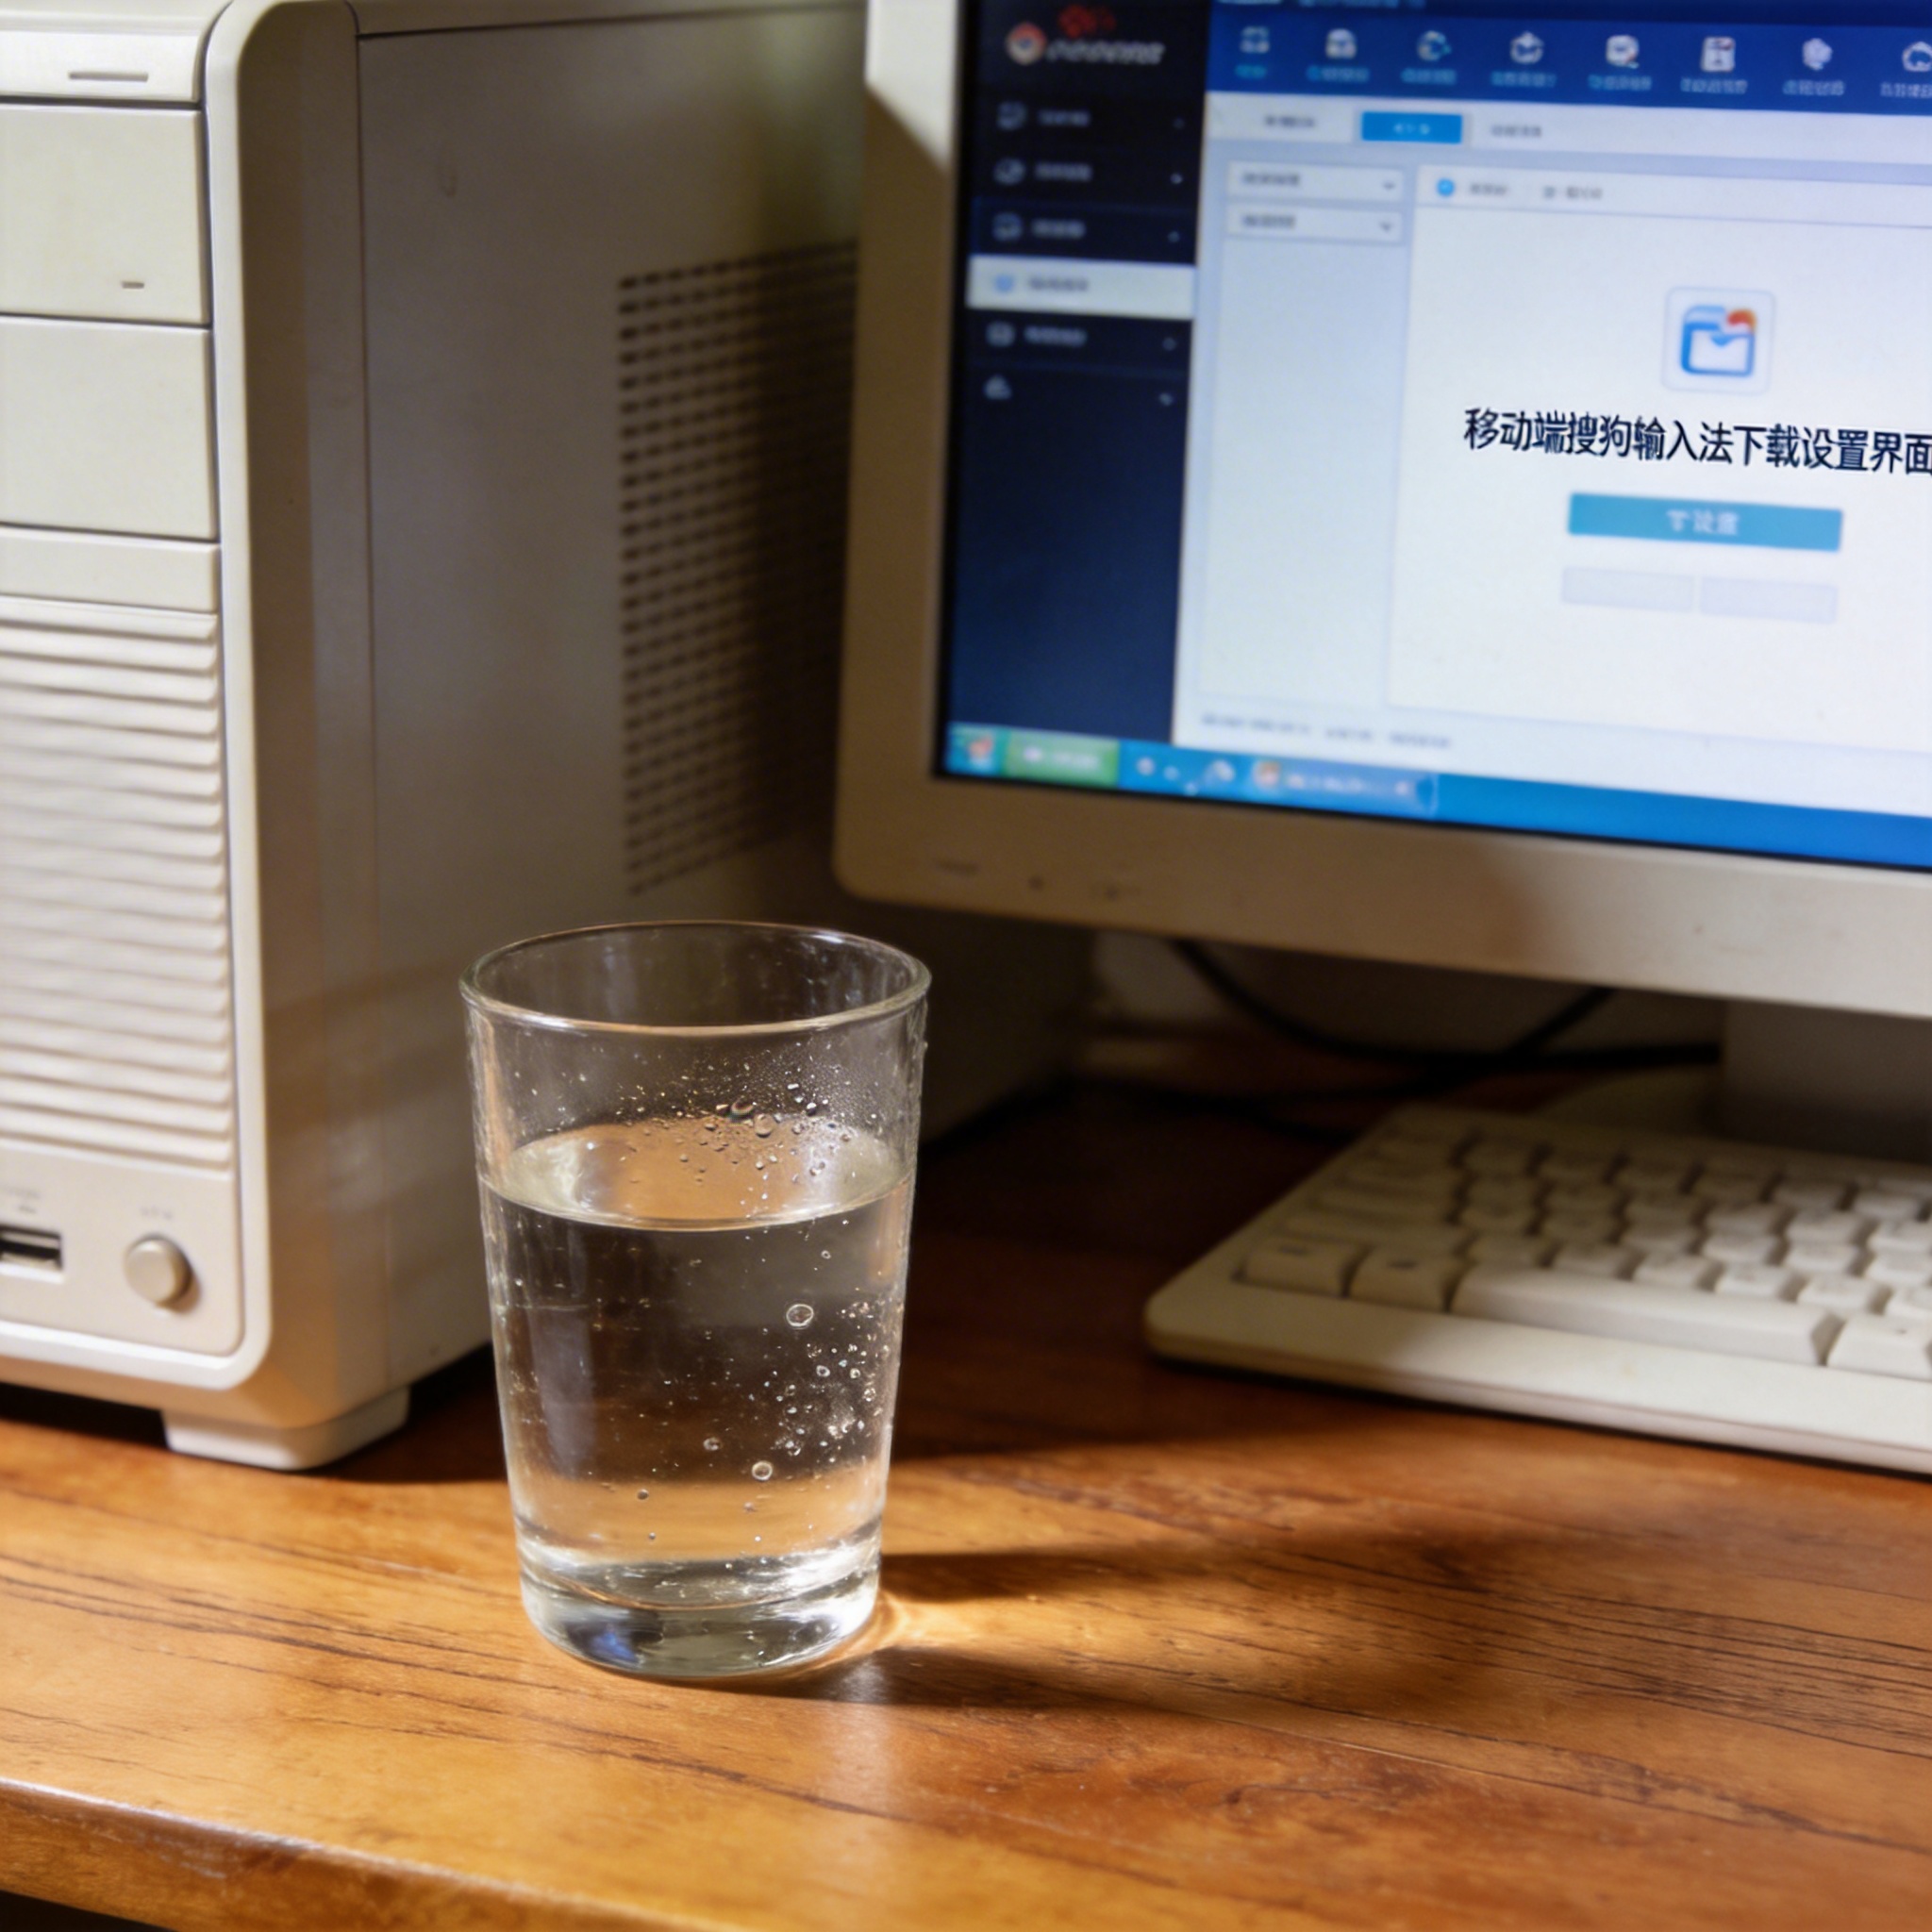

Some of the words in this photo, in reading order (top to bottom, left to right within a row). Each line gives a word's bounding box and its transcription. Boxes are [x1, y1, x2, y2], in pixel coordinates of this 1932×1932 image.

[1464, 407, 1932, 475] 移动端搜狗输入法下载设置界面
